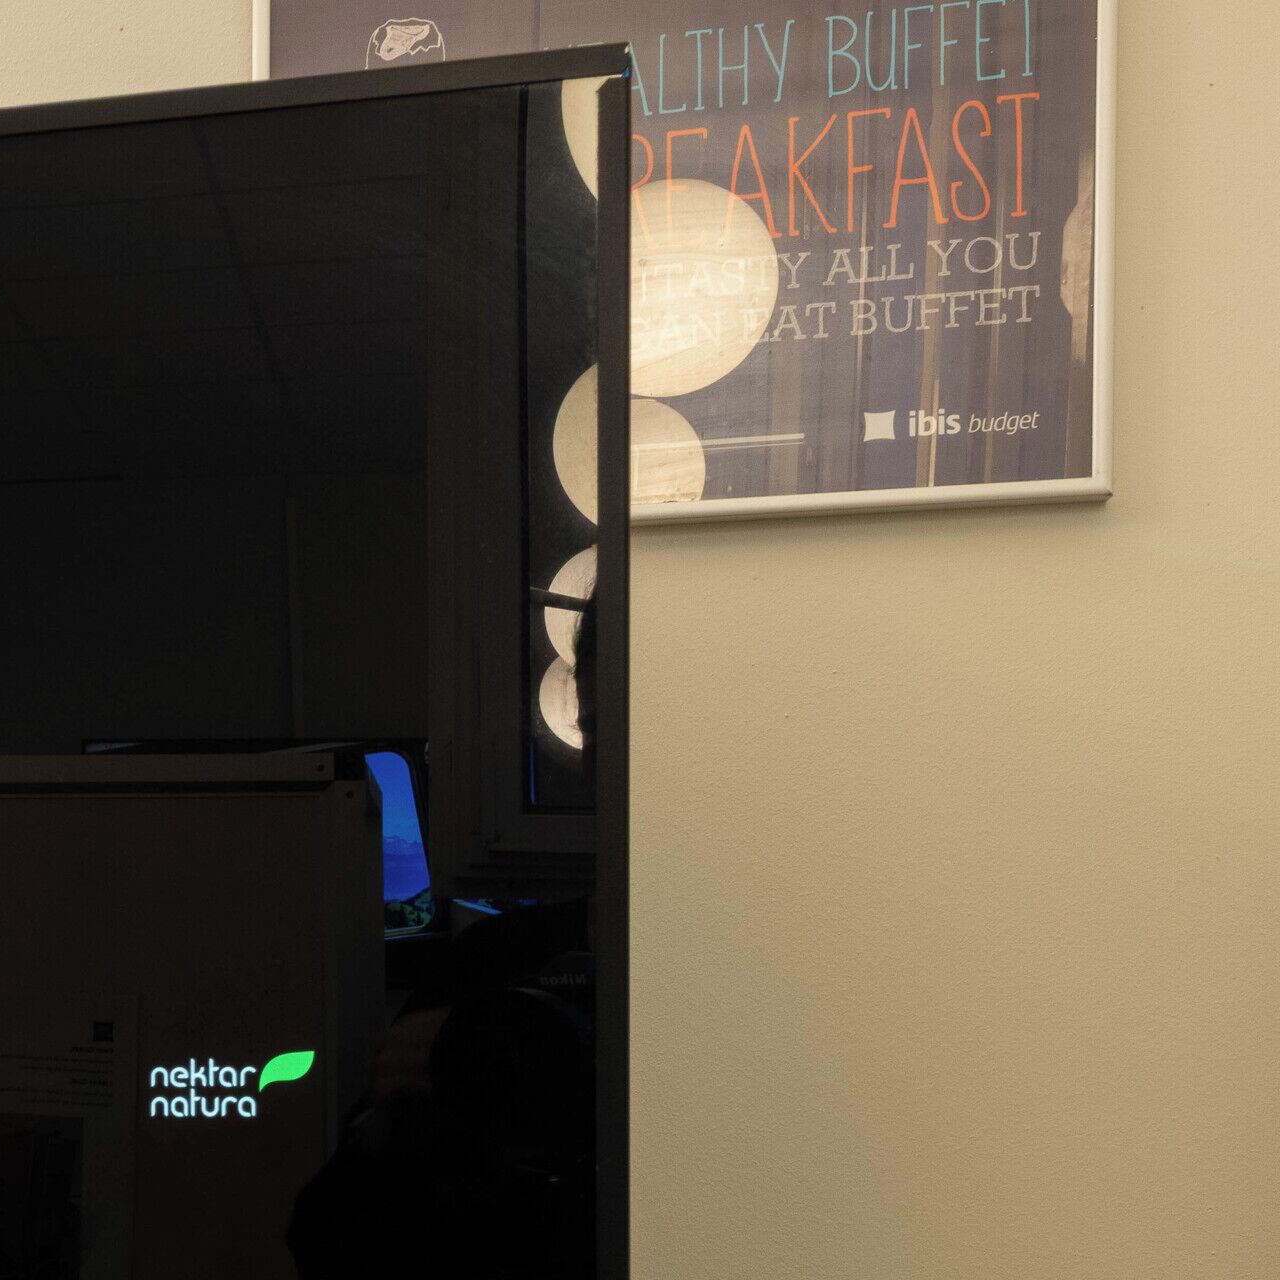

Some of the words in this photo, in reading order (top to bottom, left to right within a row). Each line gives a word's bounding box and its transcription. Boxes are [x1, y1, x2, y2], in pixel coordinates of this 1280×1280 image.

[825, 0, 1034, 97] BUFFET
[631, 92, 1041, 248] REAKFAST
[822, 243, 915, 286] ALL
[927, 232, 1042, 277] YOU
[742, 302, 836, 344] EAT
[850, 285, 1041, 336] BUFFET
[908, 409, 961, 436] ibis
[968, 410, 1041, 435] budget
[150, 1057, 257, 1087] nektar
[150, 1088, 257, 1117] natura
